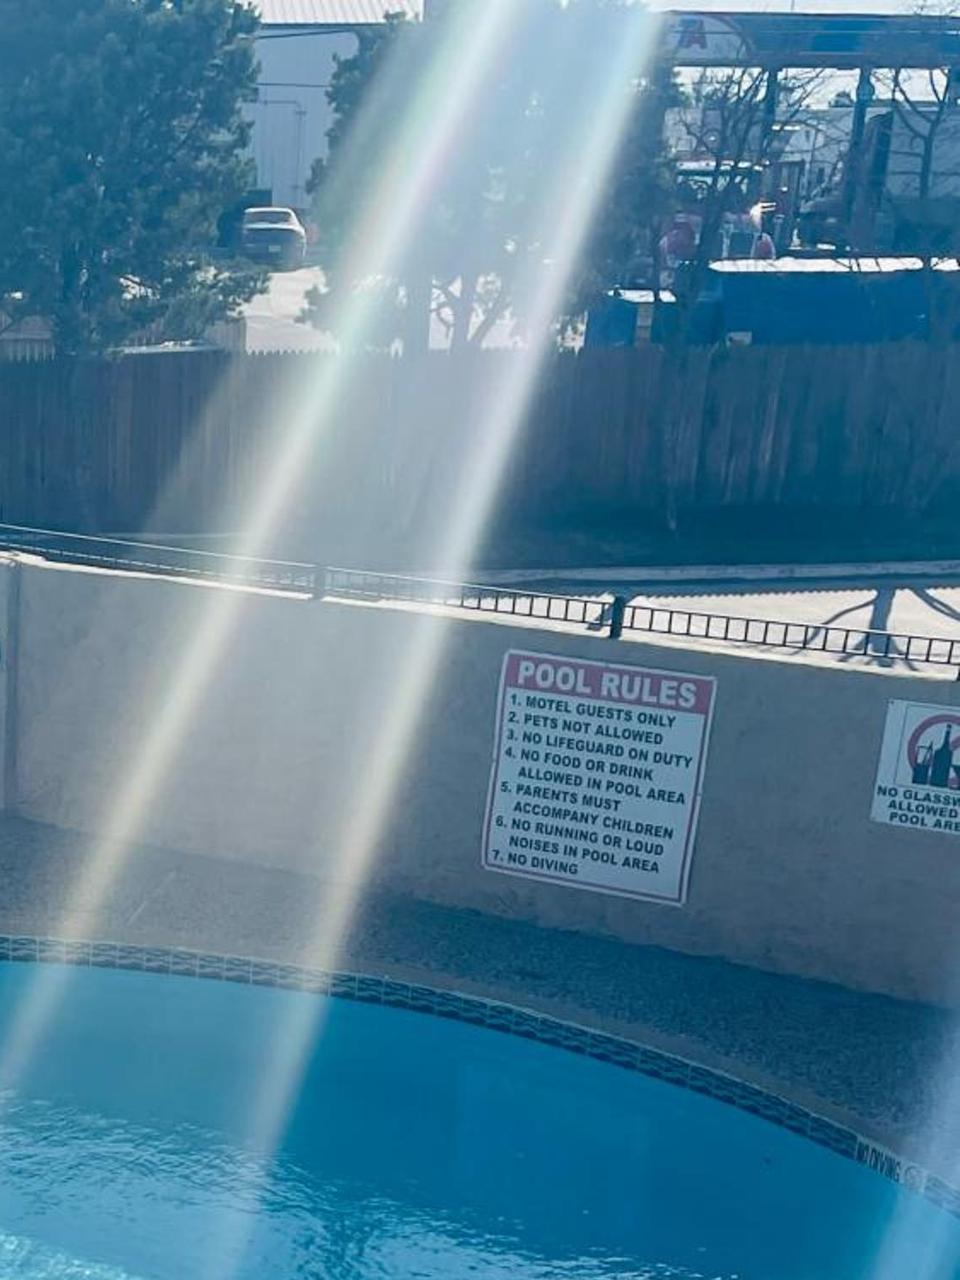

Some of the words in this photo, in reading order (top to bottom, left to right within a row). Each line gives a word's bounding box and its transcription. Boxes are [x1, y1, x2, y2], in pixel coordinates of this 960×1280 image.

[517, 660, 592, 694] POOL
[600, 672, 697, 708] RULES
[510, 693, 522, 706] 1.
[526, 696, 572, 713] MOTEL
[576, 703, 632, 722] GUESTS
[637, 712, 676, 728] ONLY
[508, 712, 519, 724] 2.
[524, 714, 558, 729] PETS
[562, 719, 592, 735] NOT
[594, 724, 663, 745] ALLOWED
[505, 747, 516, 759] 4.
[520, 749, 539, 762] NO
[544, 752, 582, 769] FOOD
[585, 759, 606, 773] OR
[609, 763, 655, 782] DRINK
[507, 729, 518, 742] 3.
[522, 731, 542, 745] NO
[546, 734, 625, 757] LIFEGUARD
[628, 748, 649, 762] ON
[653, 751, 693, 770] DUTY
[500, 781, 512, 793] 5.
[516, 783, 578, 805] PARENTS
[582, 796, 621, 812] MUST
[518, 766, 583, 787] ALLOWED
[587, 775, 602, 790] IN
[606, 779, 647, 798] POOL
[646, 787, 686, 805] AREA
[877, 785, 898, 798] NO
[513, 801, 599, 826] ACCOMPANY
[602, 816, 674, 840] CHILDREN
[888, 799, 958, 818] ALLOWED
[889, 811, 927, 827] POOL
[495, 815, 507, 828] 6.
[511, 818, 531, 832] NO
[534, 821, 598, 845] RUNNING
[602, 834, 622, 848] OR
[626, 838, 664, 856] LOUD
[492, 849, 504, 862] 7.
[507, 852, 527, 866] NO
[531, 857, 579, 875] DIVING
[509, 835, 560, 855] NOISES
[563, 844, 579, 858] IN
[582, 848, 618, 866] POOL
[621, 855, 660, 874] AREA
